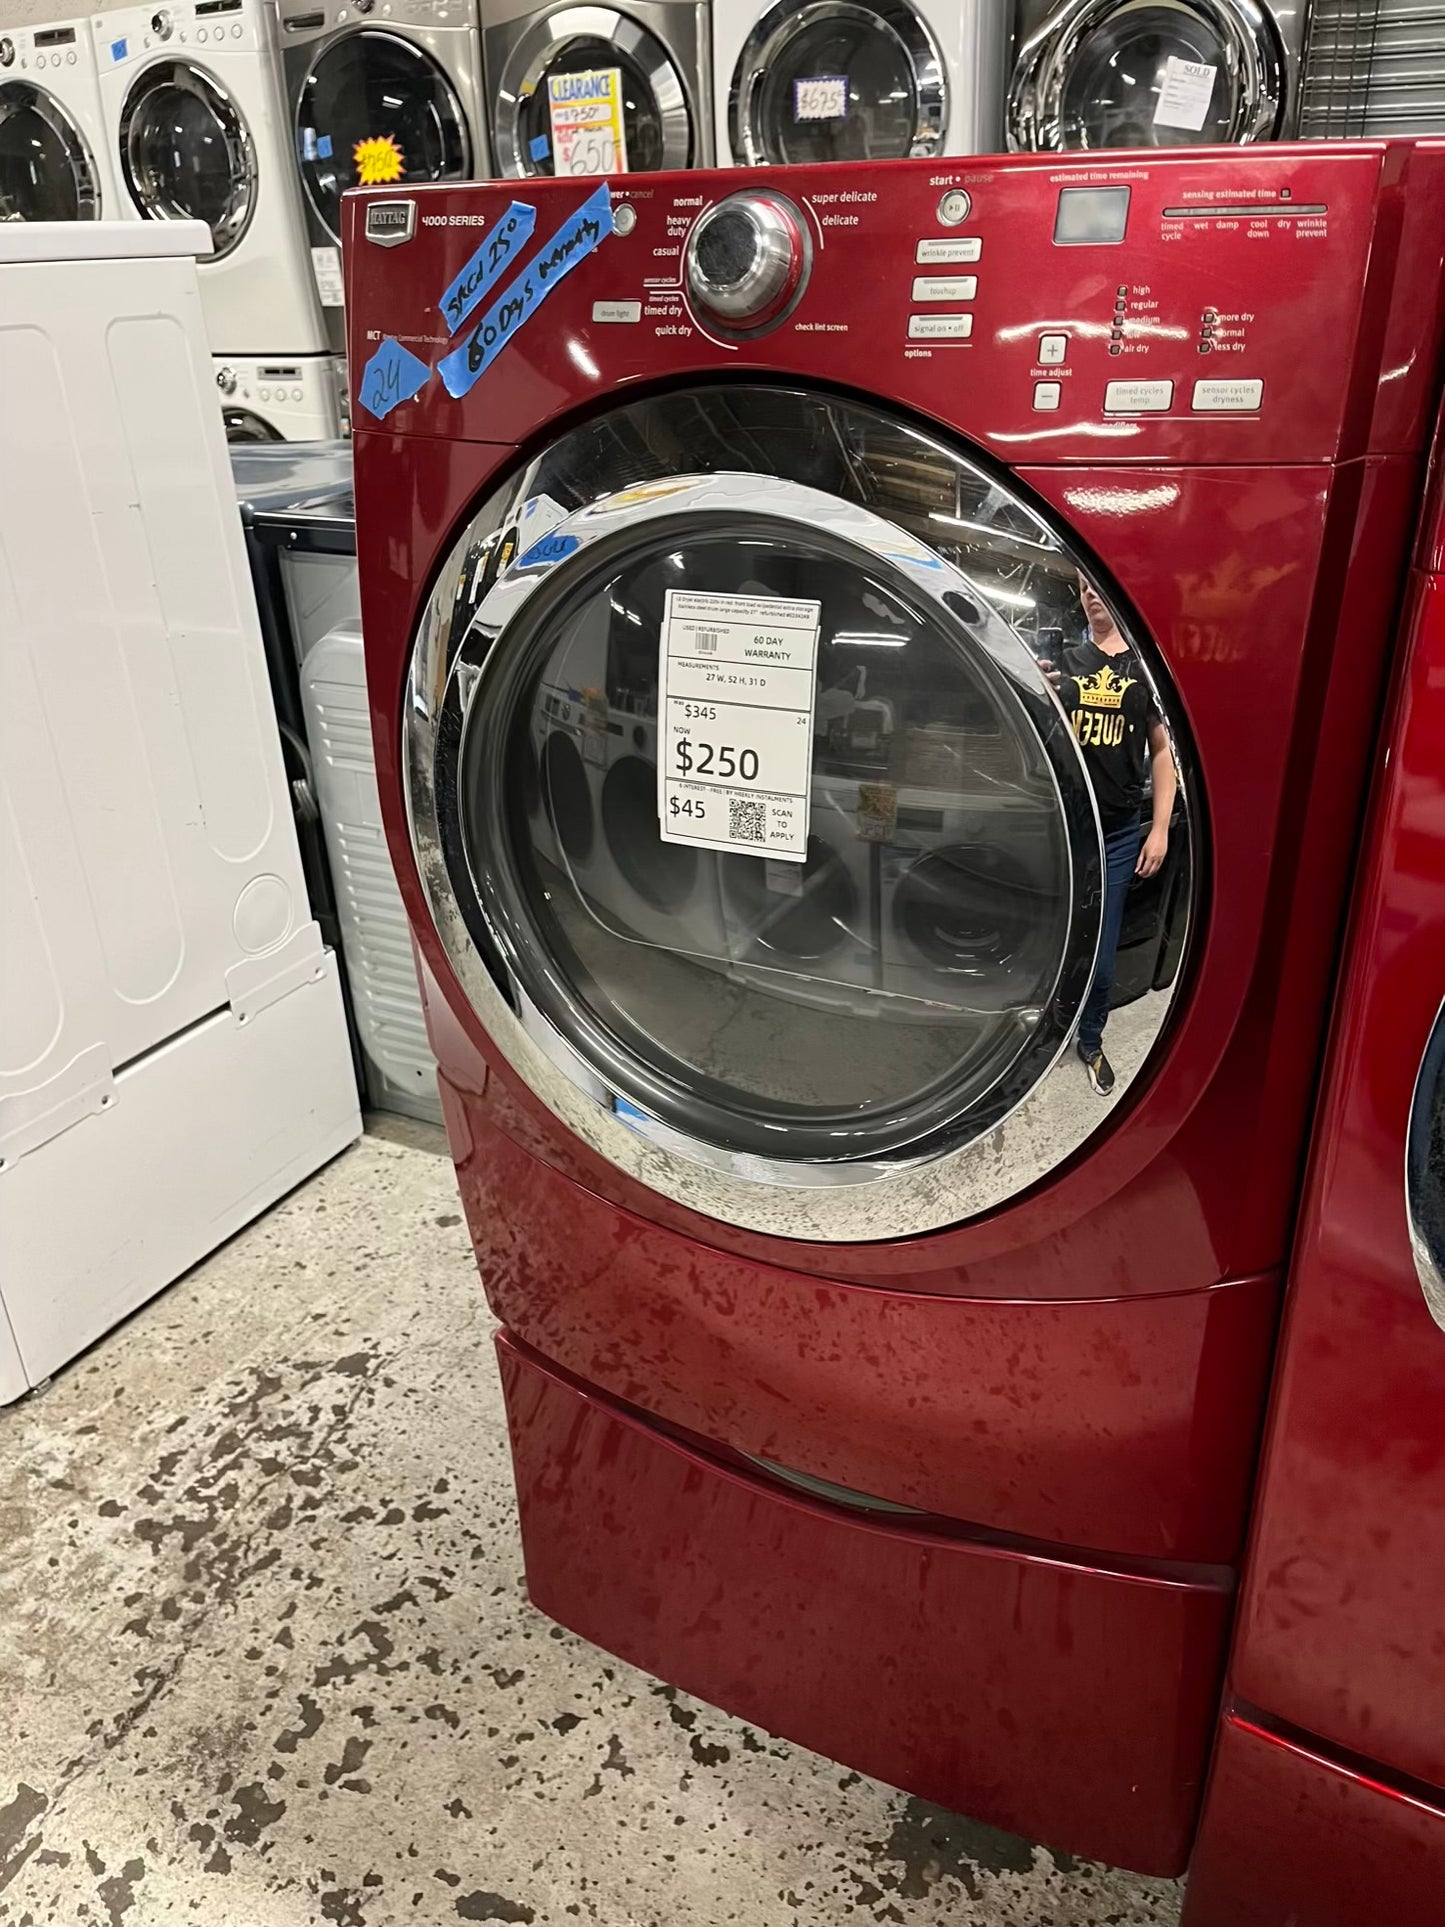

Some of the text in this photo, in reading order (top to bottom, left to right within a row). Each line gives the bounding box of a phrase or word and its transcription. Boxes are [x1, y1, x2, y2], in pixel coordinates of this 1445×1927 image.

[1184, 64, 1211, 77] SOLD
[551, 75, 610, 102] CLEARANCE
[929, 175, 953, 186] start
[1050, 171, 1149, 183] estimated time remaining
[630, 189, 654, 199] cancel
[812, 190, 877, 205] super delicate
[1182, 189, 1276, 200] sensing estimated time
[673, 195, 703, 207] normal
[370, 211, 406, 225] MAYTAG
[422, 215, 485, 227] 4000 SERIES
[667, 215, 691, 227] heavy
[822, 214, 859, 226] delicate
[1161, 218, 1327, 231] timed wet damp cool dry wrinkle
[667, 226, 686, 238] duty
[1161, 228, 1327, 241] cycle down prevent
[653, 247, 679, 257] casual
[921, 248, 974, 258] wrinkle prevent
[930, 287, 957, 297] touchup
[1133, 285, 1151, 296] high
[1130, 300, 1159, 311] regular
[616, 310, 630, 319] light
[644, 305, 682, 318] timed dry
[1219, 313, 1255, 323] more dry
[655, 325, 692, 338] quick dry
[795, 323, 848, 332] check lint screen
[914, 325, 936, 334] signal
[953, 324, 964, 332] off
[366, 330, 381, 340] MCT
[1124, 344, 1149, 355] air dry
[1231, 342, 1246, 353] dry
[904, 348, 932, 359] options
[1030, 367, 1072, 379] time adjust
[372, 358, 401, 411] 24
[1116, 386, 1164, 397] timed cycles
[1202, 386, 1255, 396] sensor cycles
[1130, 396, 1150, 406] temp
[1212, 395, 1244, 405] dryness
[753, 635, 784, 647] 60 DAY
[744, 649, 791, 661] WARRANTY
[678, 661, 720, 671] MEASUREMENTS
[706, 673, 766, 687] 27 W, 52 H, 31 D
[685, 705, 717, 721] $345
[797, 717, 807, 725] 24
[673, 726, 691, 735] NOW
[676, 737, 760, 781] $250
[756, 794, 793, 803] INSTALMENTS
[669, 795, 706, 819] $45
[772, 808, 793, 818] SCAN
[777, 821, 788, 829] TO
[770, 831, 795, 842] APPLY
